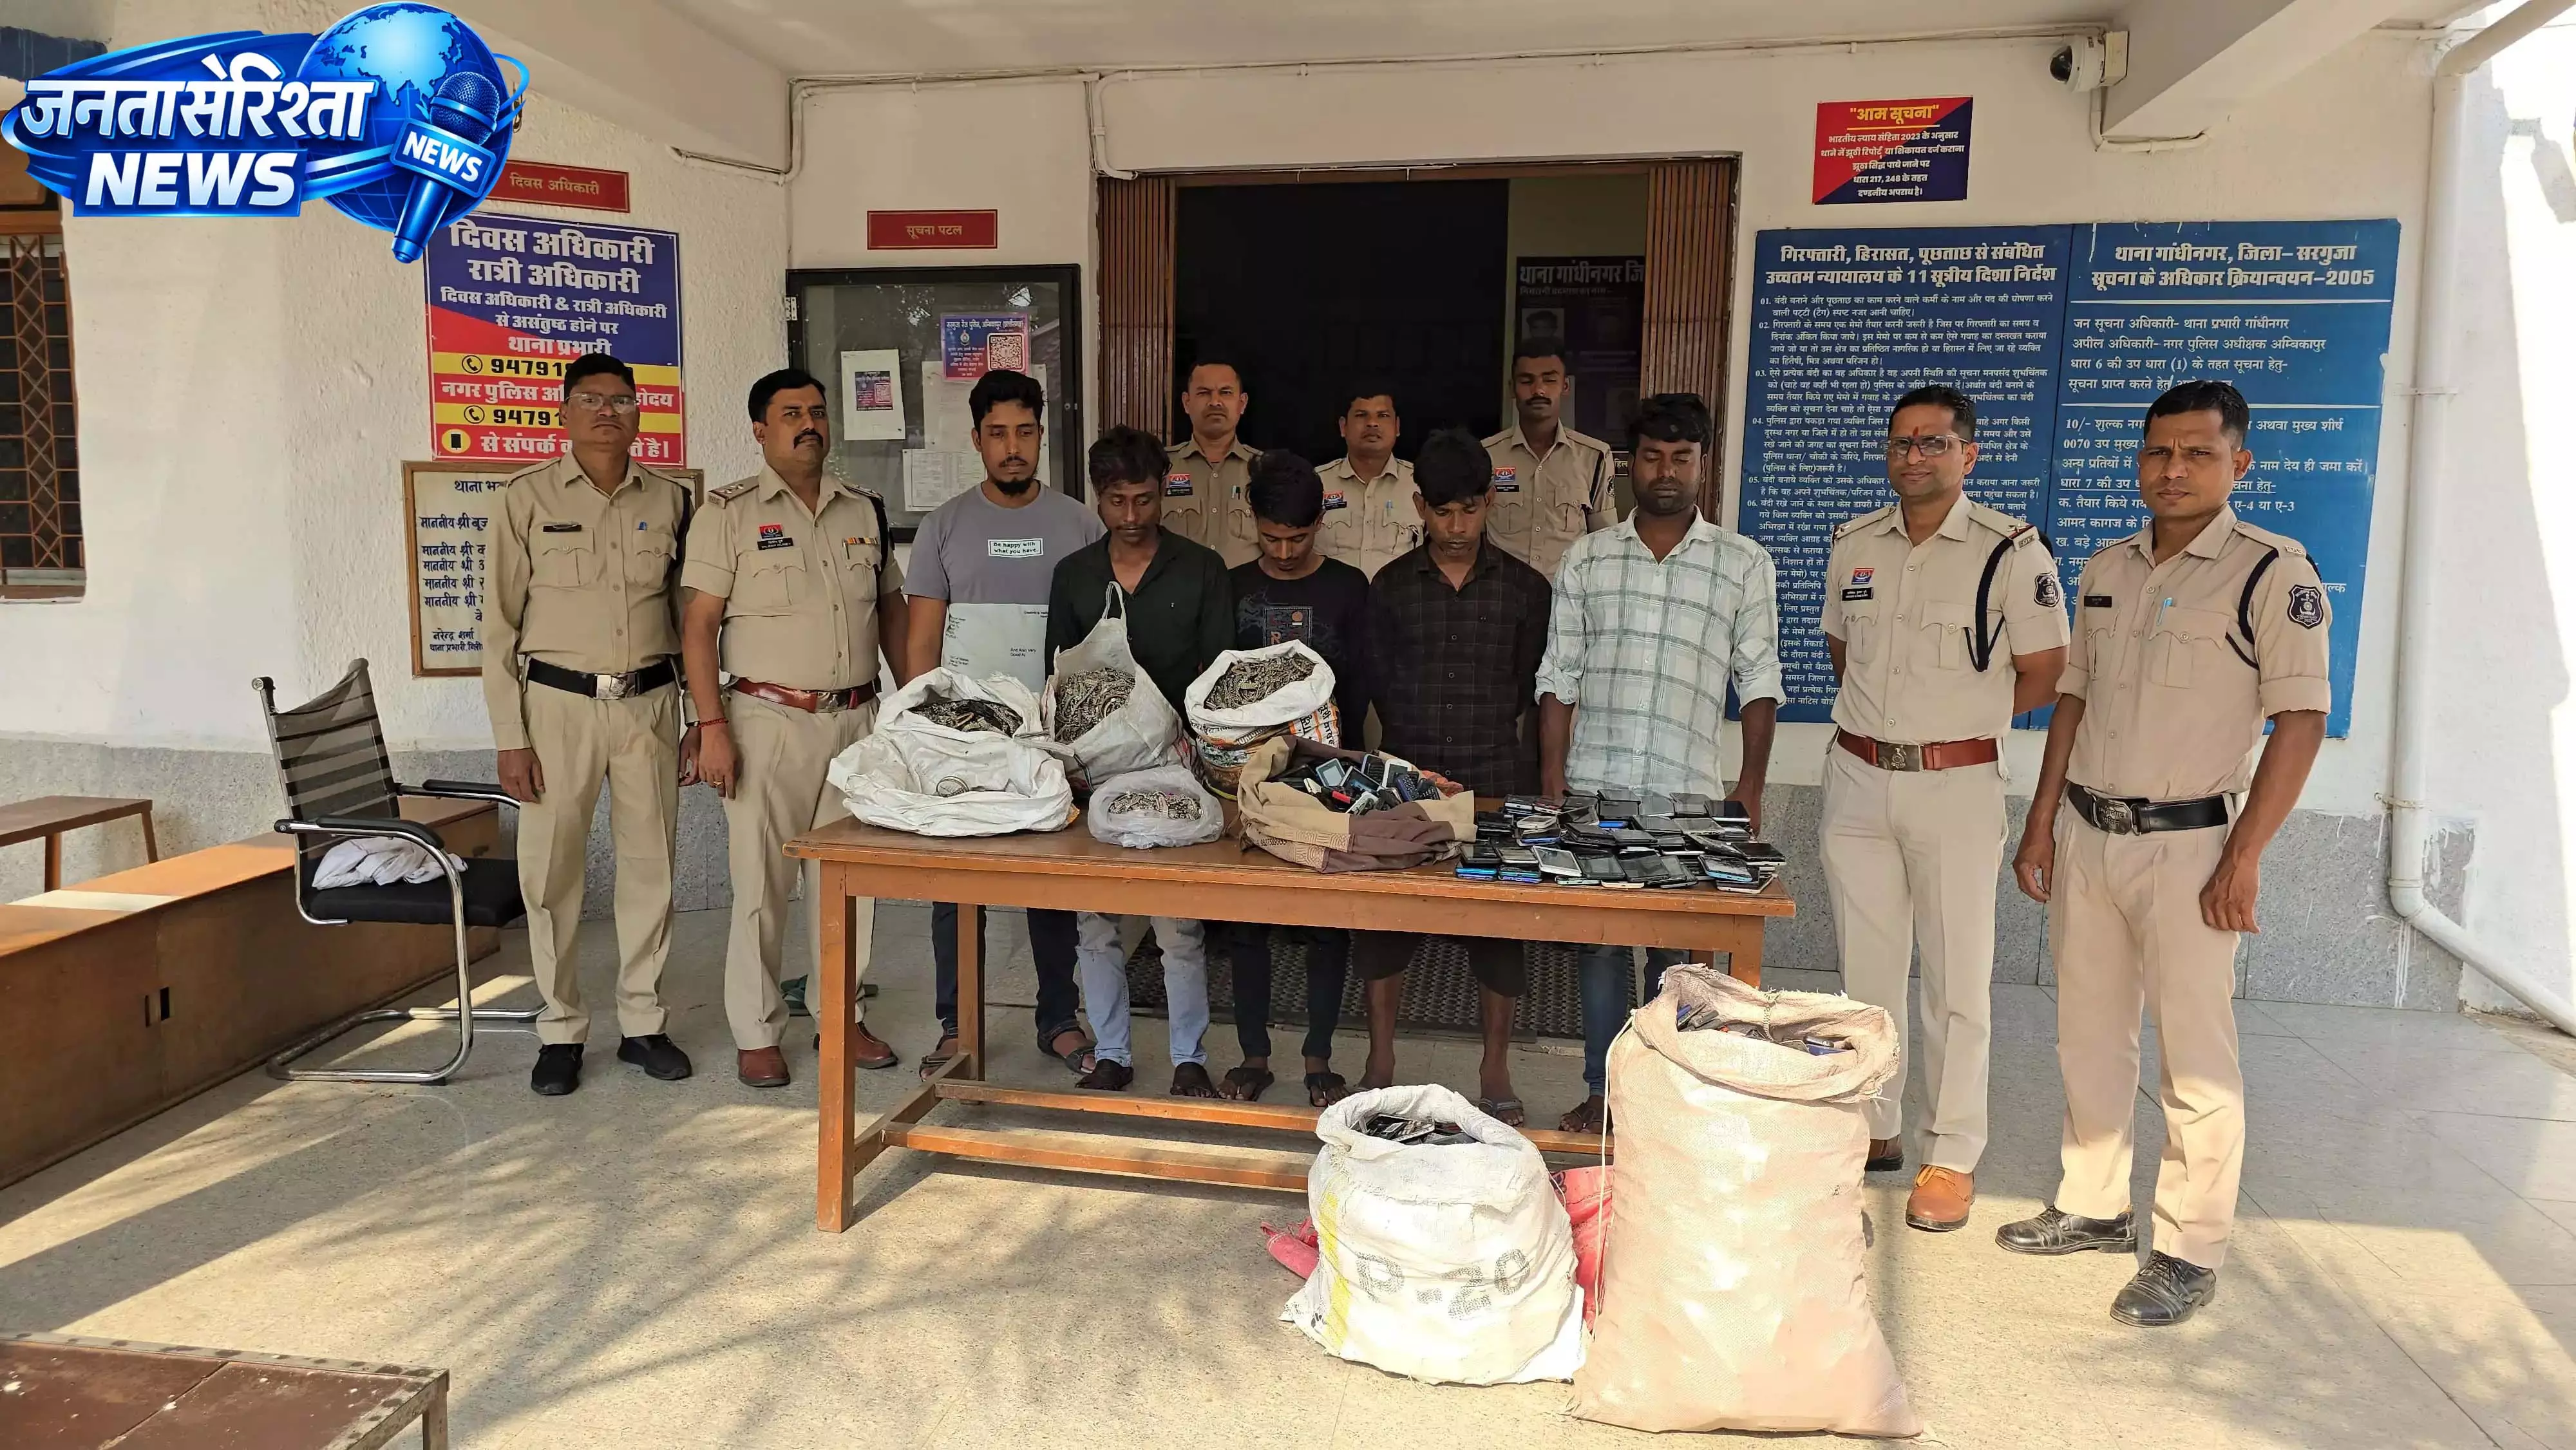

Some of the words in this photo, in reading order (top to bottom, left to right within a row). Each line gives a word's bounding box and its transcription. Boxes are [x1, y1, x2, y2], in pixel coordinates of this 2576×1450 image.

[509, 171, 543, 189] दिवस
[547, 176, 599, 195] अधिकारी
[449, 218, 527, 252] दिवस
[533, 229, 655, 264] अधिकारी
[905, 225, 935, 240] सूचना
[937, 225, 962, 235] पटल
[1780, 245, 1851, 264] गिरफ्तारी,
[1855, 244, 1914, 263] हिरासत,
[1918, 247, 1973, 265] पूछताछ
[1974, 242, 1989, 259] से
[1991, 241, 2045, 259] संबंधित
[2115, 247, 2154, 261] थाना
[2155, 241, 2233, 264] गांधीनगर,
[2296, 245, 2357, 265] सरगुजा
[467, 258, 523, 283] रात्री
[527, 261, 641, 294] अधिकारी
[1765, 270, 1815, 284] उच्चतम
[1816, 270, 1886, 283] न्यायालय
[1886, 266, 1903, 283] के
[1907, 269, 1926, 283] 11
[1930, 265, 1974, 288] सूत्रीय
[1975, 265, 2012, 282] दिशा
[2013, 263, 2057, 281] निर्देश
[2091, 271, 2138, 291] सूचना
[2139, 267, 2156, 285] के
[2158, 267, 2225, 286] अधिकार
[440, 286, 482, 304] दिवस
[484, 290, 552, 309] अधिकारी
[554, 296, 569, 310] &
[572, 297, 603, 313] रात्री
[605, 300, 667, 318] अधिकारी
[495, 310, 510, 326] से
[512, 315, 567, 334] असंतुष्ट
[569, 316, 598, 333] होने
[599, 322, 619, 334] पर
[2073, 319, 2091, 328] जन
[2094, 319, 2125, 332] सूचना
[2128, 315, 2179, 329] अधिकारी-
[2184, 319, 2208, 328] थाना
[2211, 315, 2241, 329] प्रभारी
[2244, 315, 2289, 328] गांधीनगर
[2072, 335, 2104, 348] अपील
[2108, 335, 2161, 350] अधिकारी-
[2163, 339, 2184, 349] नगर
[2187, 335, 2219, 352] पुलिस
[2222, 335, 2267, 350] अधीक्षक
[2270, 335, 2326, 352] अम्बिकापुर
[2070, 359, 2092, 369] धारा
[2095, 359, 2102, 369] 6
[2107, 356, 2122, 368] की
[2126, 359, 2141, 369] उप
[2145, 359, 2166, 370] धारा
[2170, 357, 2187, 372] (1)
[2192, 356, 2204, 369] के
[2207, 359, 2230, 370] तहत
[2233, 360, 2264, 373] सूचना
[440, 381, 482, 397] नगर
[484, 381, 538, 404] पुलिस
[2068, 379, 2098, 393] सूचना
[2101, 379, 2125, 389] प्राप्त
[2128, 376, 2153, 389] करने
[2094, 419, 2124, 432] शुल्क
[2255, 420, 2288, 430] अथवा
[2291, 420, 2317, 434] मुख्य
[2320, 417, 2344, 431] शीर्ष
[480, 431, 500, 452] से
[502, 432, 556, 453] संपर्क
[2063, 438, 2090, 449] 0070
[2094, 439, 2110, 448] उप
[2114, 439, 2139, 452] मुख्य
[2061, 458, 2085, 471] अन्य
[2088, 456, 2119, 468] प्रतियों
[2123, 456, 2133, 469] में
[2259, 460, 2280, 470] नाम
[2283, 459, 2300, 471] देय
[2303, 459, 2316, 472] ही
[2318, 462, 2342, 471] जमा
[454, 480, 484, 493] थाना
[2060, 478, 2081, 487] धारा
[2085, 478, 2092, 488] 7
[2096, 476, 2112, 488] की
[2116, 479, 2131, 489] उप
[2058, 498, 2071, 507] क.
[2076, 495, 2101, 508] तैयार
[2104, 496, 2128, 508] किये
[2234, 500, 2253, 513] ए-4
[2258, 501, 2271, 510] या
[2275, 501, 2295, 513] ए-3
[421, 541, 457, 556] माननीय
[459, 540, 475, 556] श्री
[422, 557, 457, 572] माननीय
[460, 556, 474, 572] श्री
[423, 574, 459, 590] माननीय
[462, 574, 475, 590] श्री
[424, 592, 461, 608] माननीय
[464, 590, 477, 608] श्री
